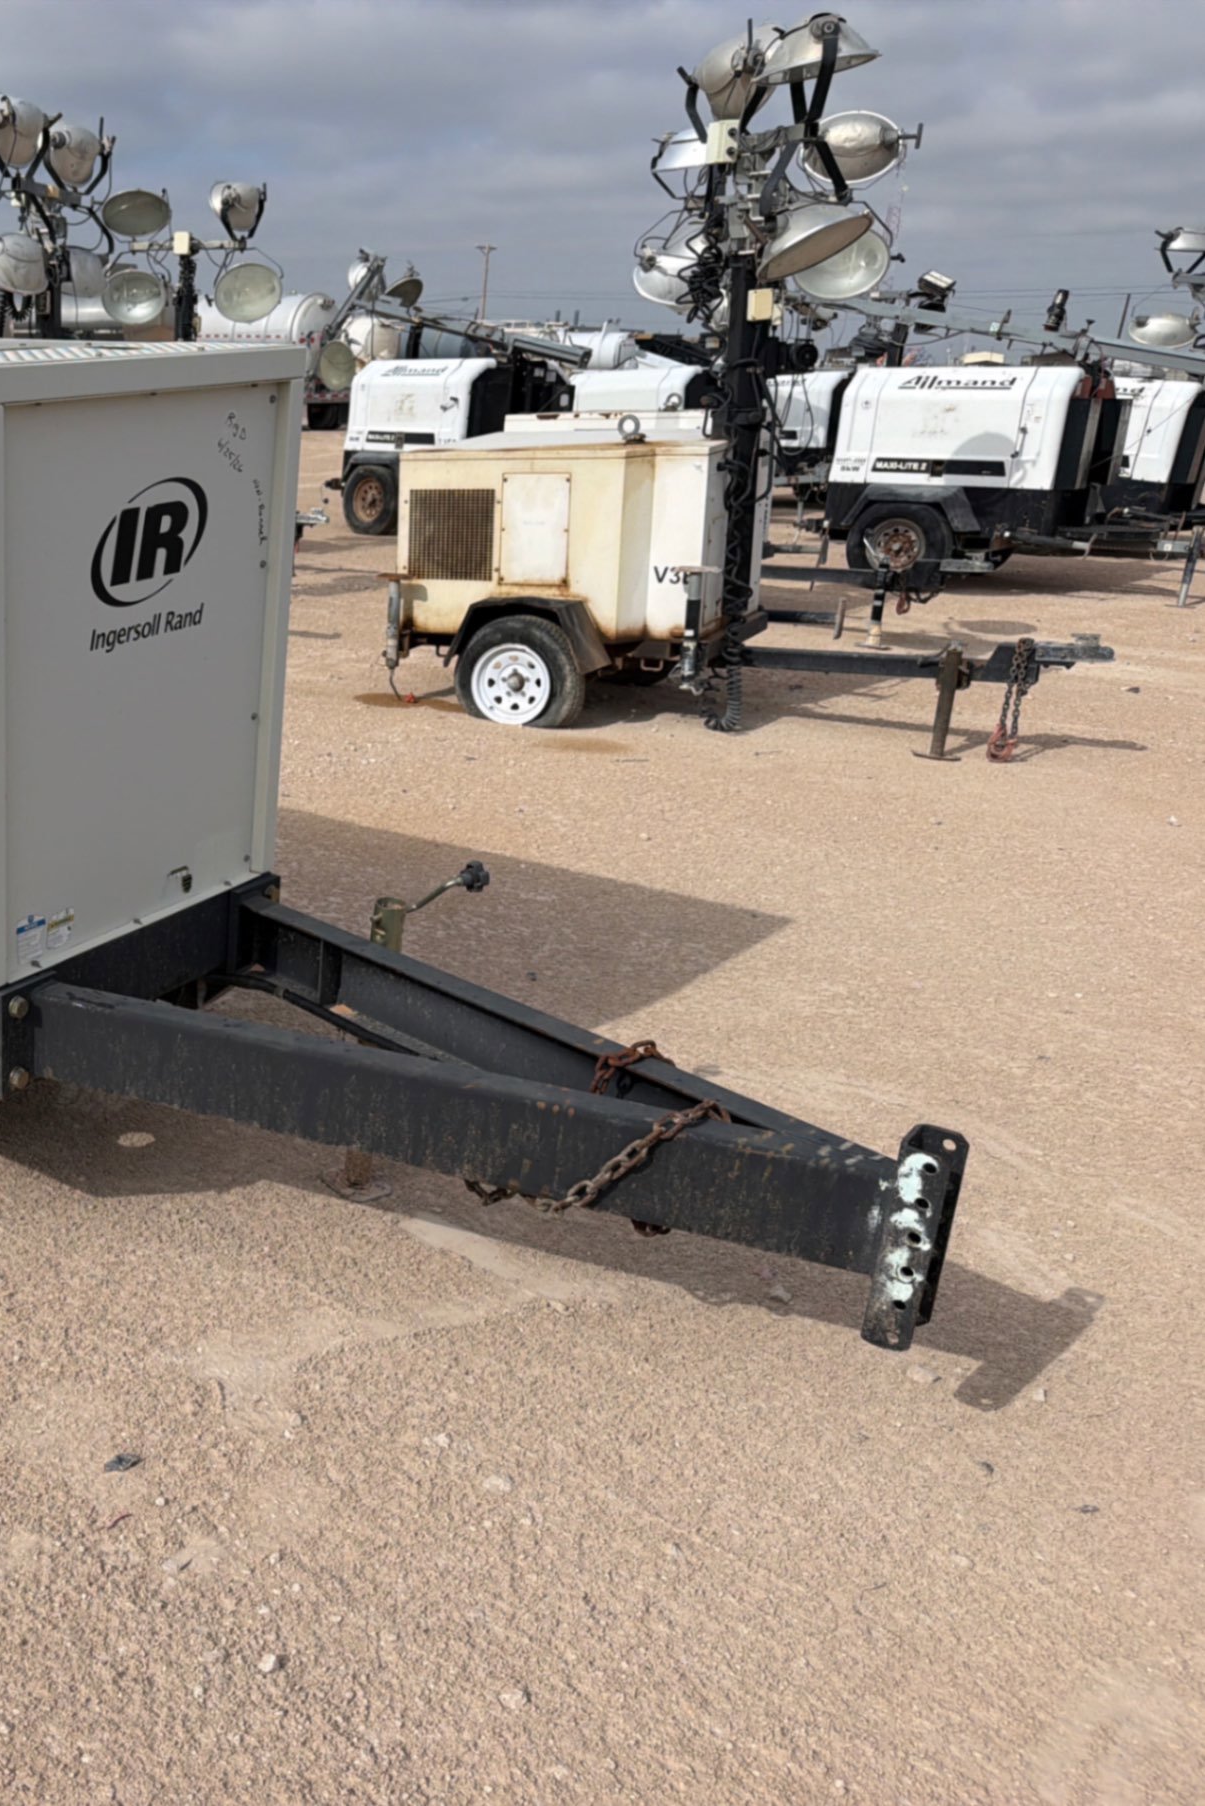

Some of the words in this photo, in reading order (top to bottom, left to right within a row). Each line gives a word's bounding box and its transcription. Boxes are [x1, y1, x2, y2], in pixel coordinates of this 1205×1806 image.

[898, 376, 1017, 390] Allmand
[110, 500, 189, 587] IR
[90, 614, 161, 653] Ingersoll
[164, 602, 204, 633] Rand
